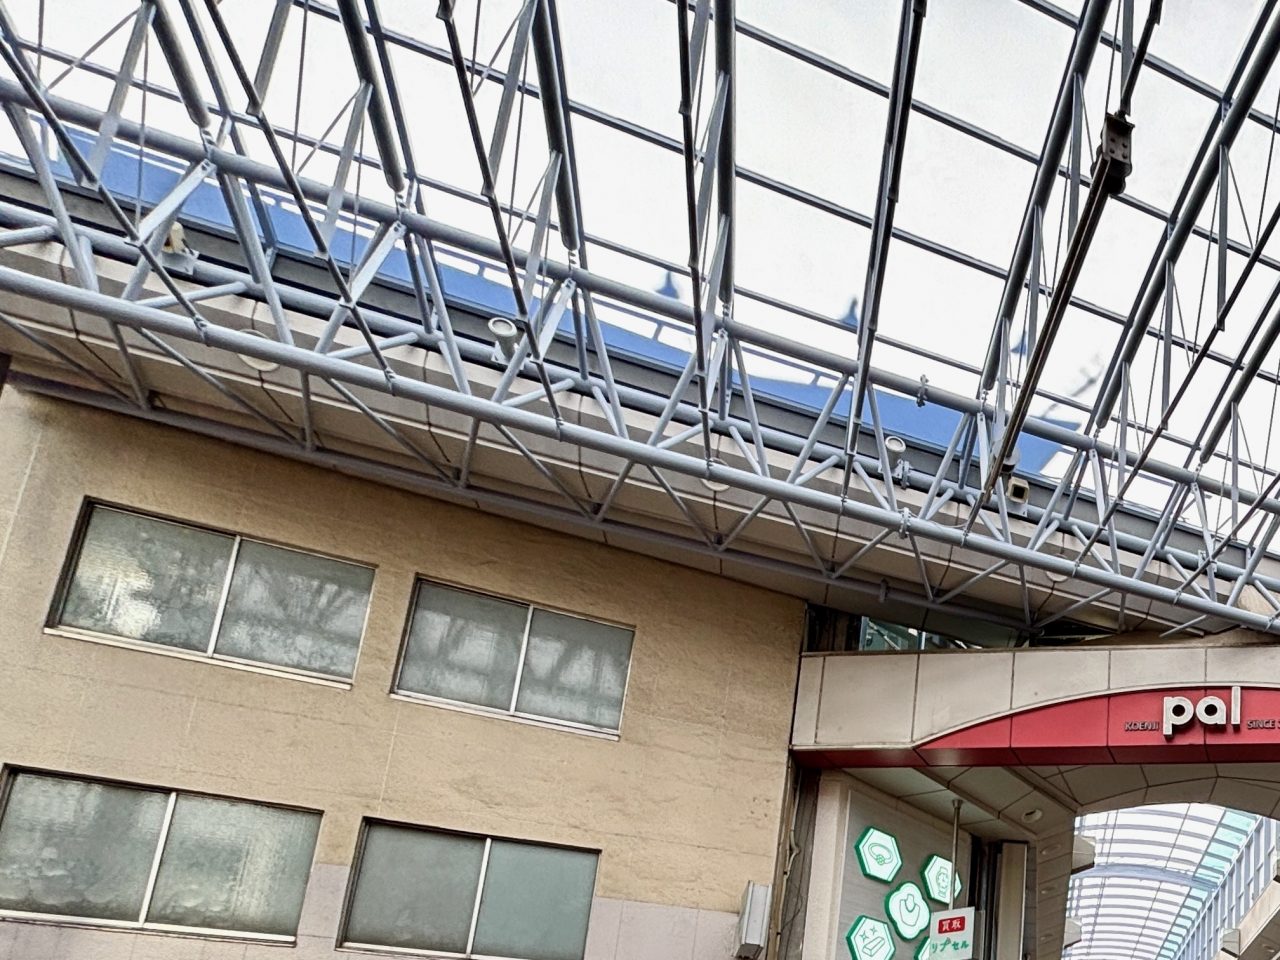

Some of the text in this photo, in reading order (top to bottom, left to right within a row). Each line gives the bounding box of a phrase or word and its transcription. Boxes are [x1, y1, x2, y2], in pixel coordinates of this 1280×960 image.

[1124, 722, 1160, 732] KOENJI
[1163, 686, 1241, 736] pal
[1247, 720, 1276, 730] SINCE
[942, 919, 962, 931] 買取
[931, 938, 969, 953] リプセル
